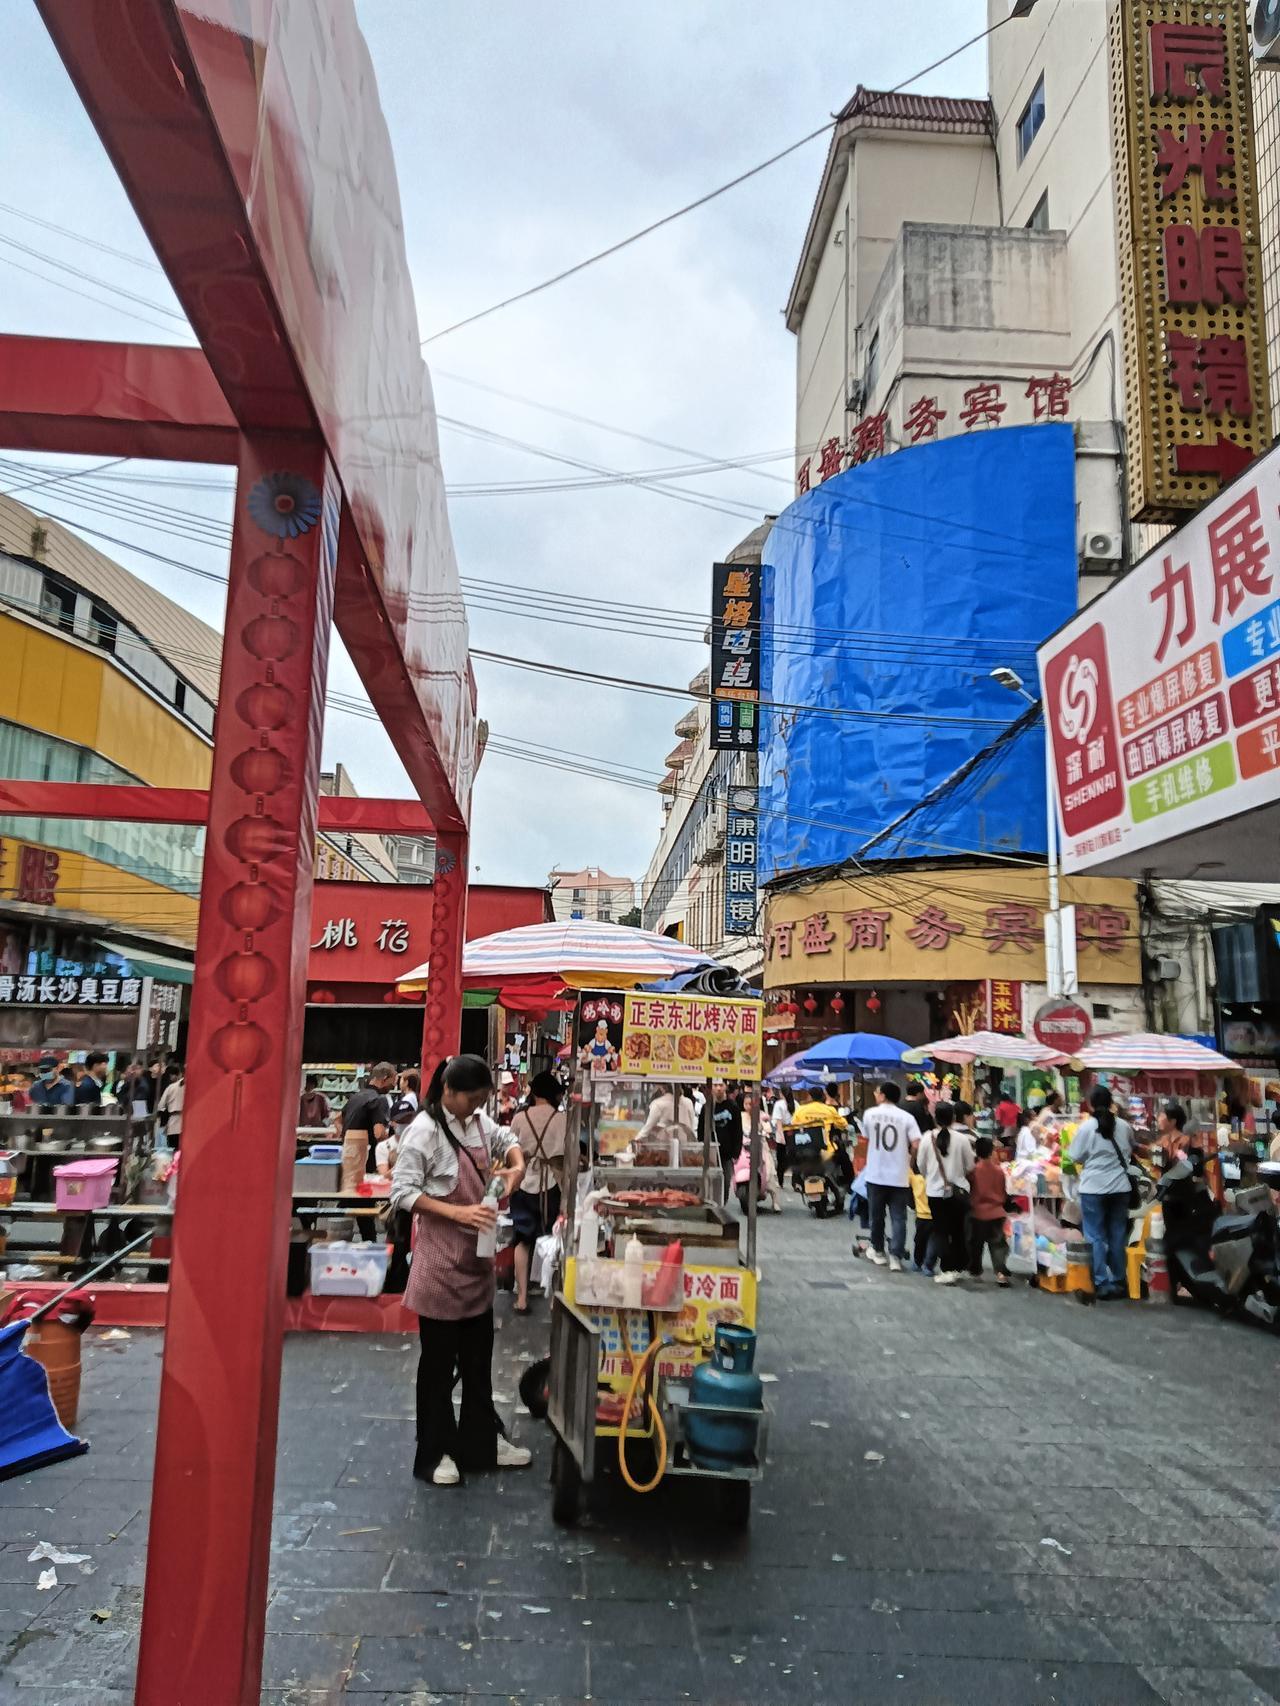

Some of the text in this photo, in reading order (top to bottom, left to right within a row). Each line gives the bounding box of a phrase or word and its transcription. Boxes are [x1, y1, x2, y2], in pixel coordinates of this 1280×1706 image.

[1149, 486, 1280, 664] 力展
[1121, 651, 1216, 730] 专业爆屏修复
[718, 729, 753, 744] 三楼
[1127, 701, 1223, 776] 曲面爆屏修复
[1064, 770, 1117, 811] SHENNAI
[1145, 757, 1213, 812] 手机维修
[729, 816, 755, 921] 康明眼镜
[310, 917, 411, 953] 桃花
[0, 975, 142, 1005] 骨汤长沙臭豆腐
[629, 1000, 758, 1034] 正宗东北烤冷面
[874, 1122, 899, 1152] 10
